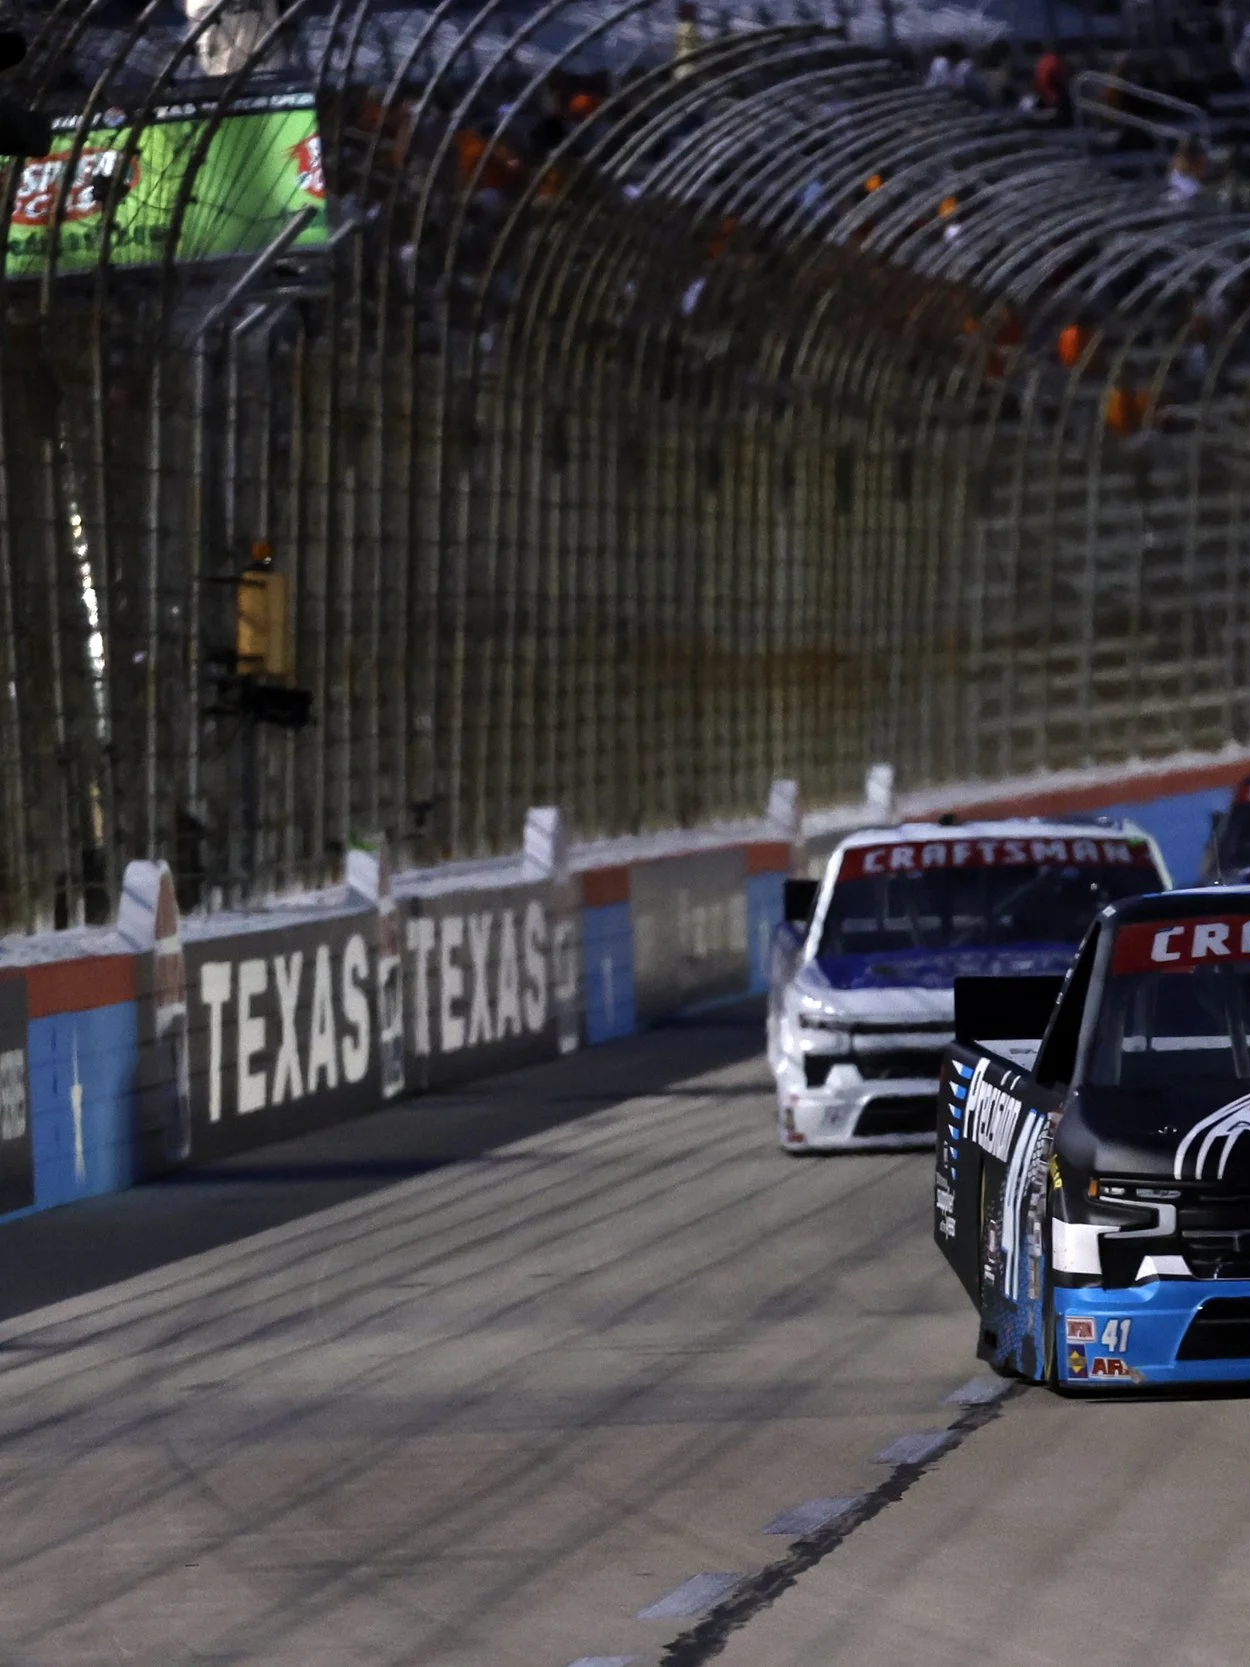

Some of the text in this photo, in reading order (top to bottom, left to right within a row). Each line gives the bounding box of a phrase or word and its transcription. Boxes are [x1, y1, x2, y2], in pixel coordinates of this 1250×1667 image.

[862, 838, 1132, 874] CRAFTSMAN
[201, 932, 371, 1123] TEXAS
[405, 900, 548, 1058] TEXAS
[1101, 1319, 1131, 1352] 41
